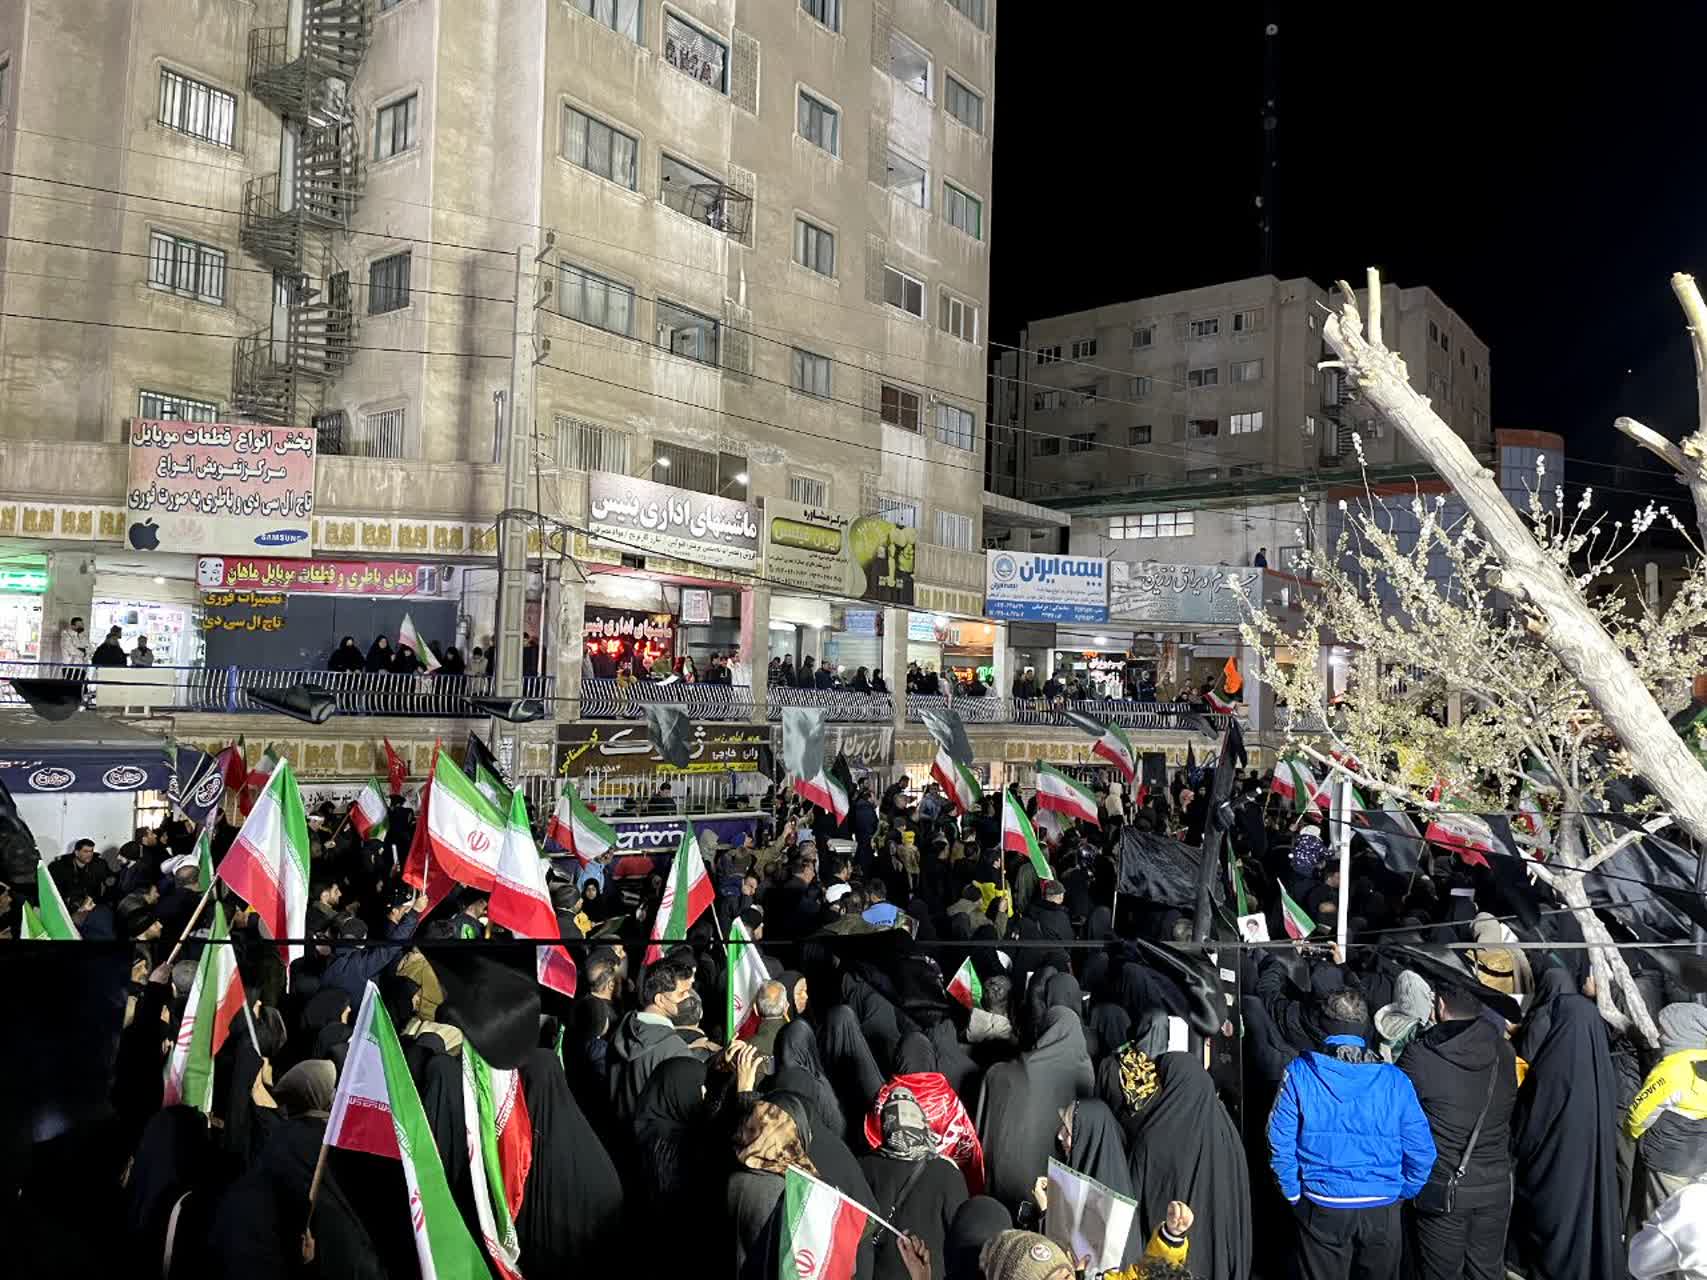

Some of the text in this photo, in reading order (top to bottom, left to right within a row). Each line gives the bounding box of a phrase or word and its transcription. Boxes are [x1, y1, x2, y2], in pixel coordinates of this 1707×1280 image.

[132, 422, 312, 457] پخش انواع قطعات موبایل
[156, 454, 195, 478] انواع
[128, 481, 156, 509] فوری
[243, 492, 260, 515] دی
[261, 498, 280, 515] سی
[640, 495, 691, 532] اداری
[690, 505, 757, 542] ماشینهای
[261, 533, 302, 543] SAMSUNG
[226, 562, 260, 586] ماهان
[262, 563, 297, 586] موبایل
[298, 564, 337, 585] قطعات
[348, 566, 381, 588] باطری
[383, 569, 414, 588] دنیای
[1020, 556, 1104, 587] بیمه ایران
[204, 591, 235, 609] فوری
[202, 614, 222, 631] دی
[223, 617, 246, 630] سی
